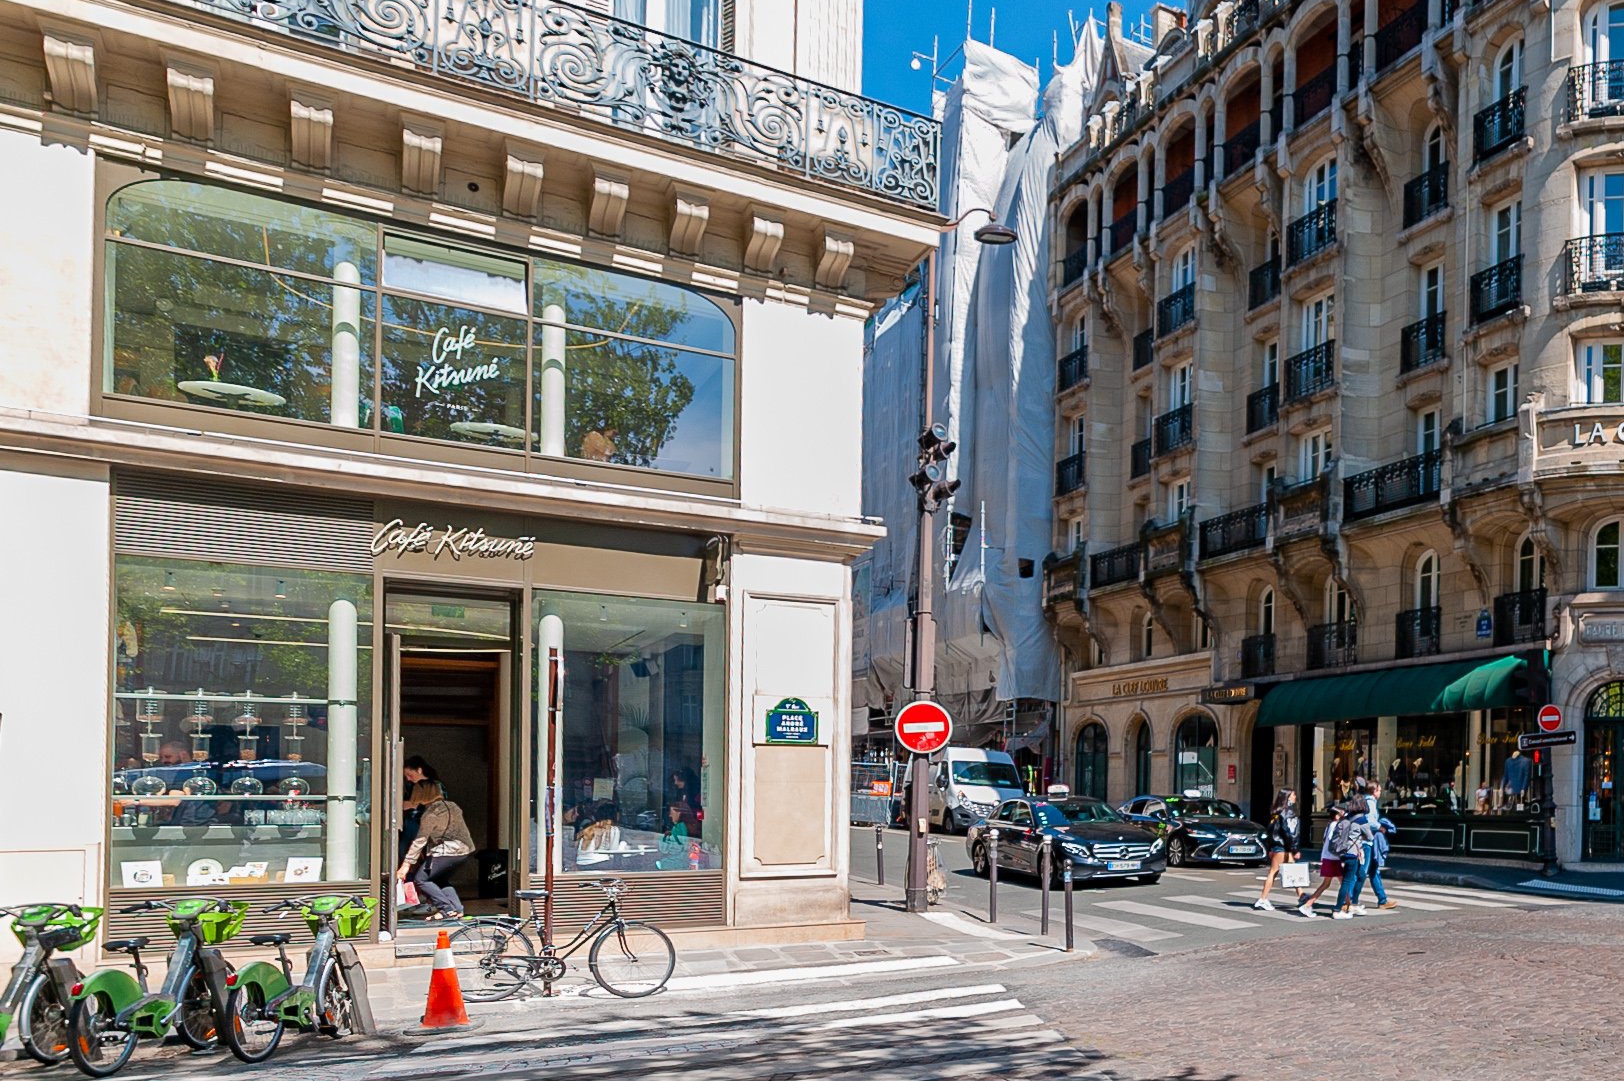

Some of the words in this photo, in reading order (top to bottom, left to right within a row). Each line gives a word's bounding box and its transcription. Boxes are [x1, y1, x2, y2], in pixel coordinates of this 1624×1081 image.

[432, 325, 476, 363] Café
[415, 357, 500, 398] Kitsuné
[1574, 422, 1606, 444] LA
[370, 518, 434, 554] Café
[434, 524, 537, 557] Kitsuné
[1112, 684, 1121, 696] LA
[1123, 681, 1139, 694] CLEF
[1140, 678, 1168, 693] LOUVRE
